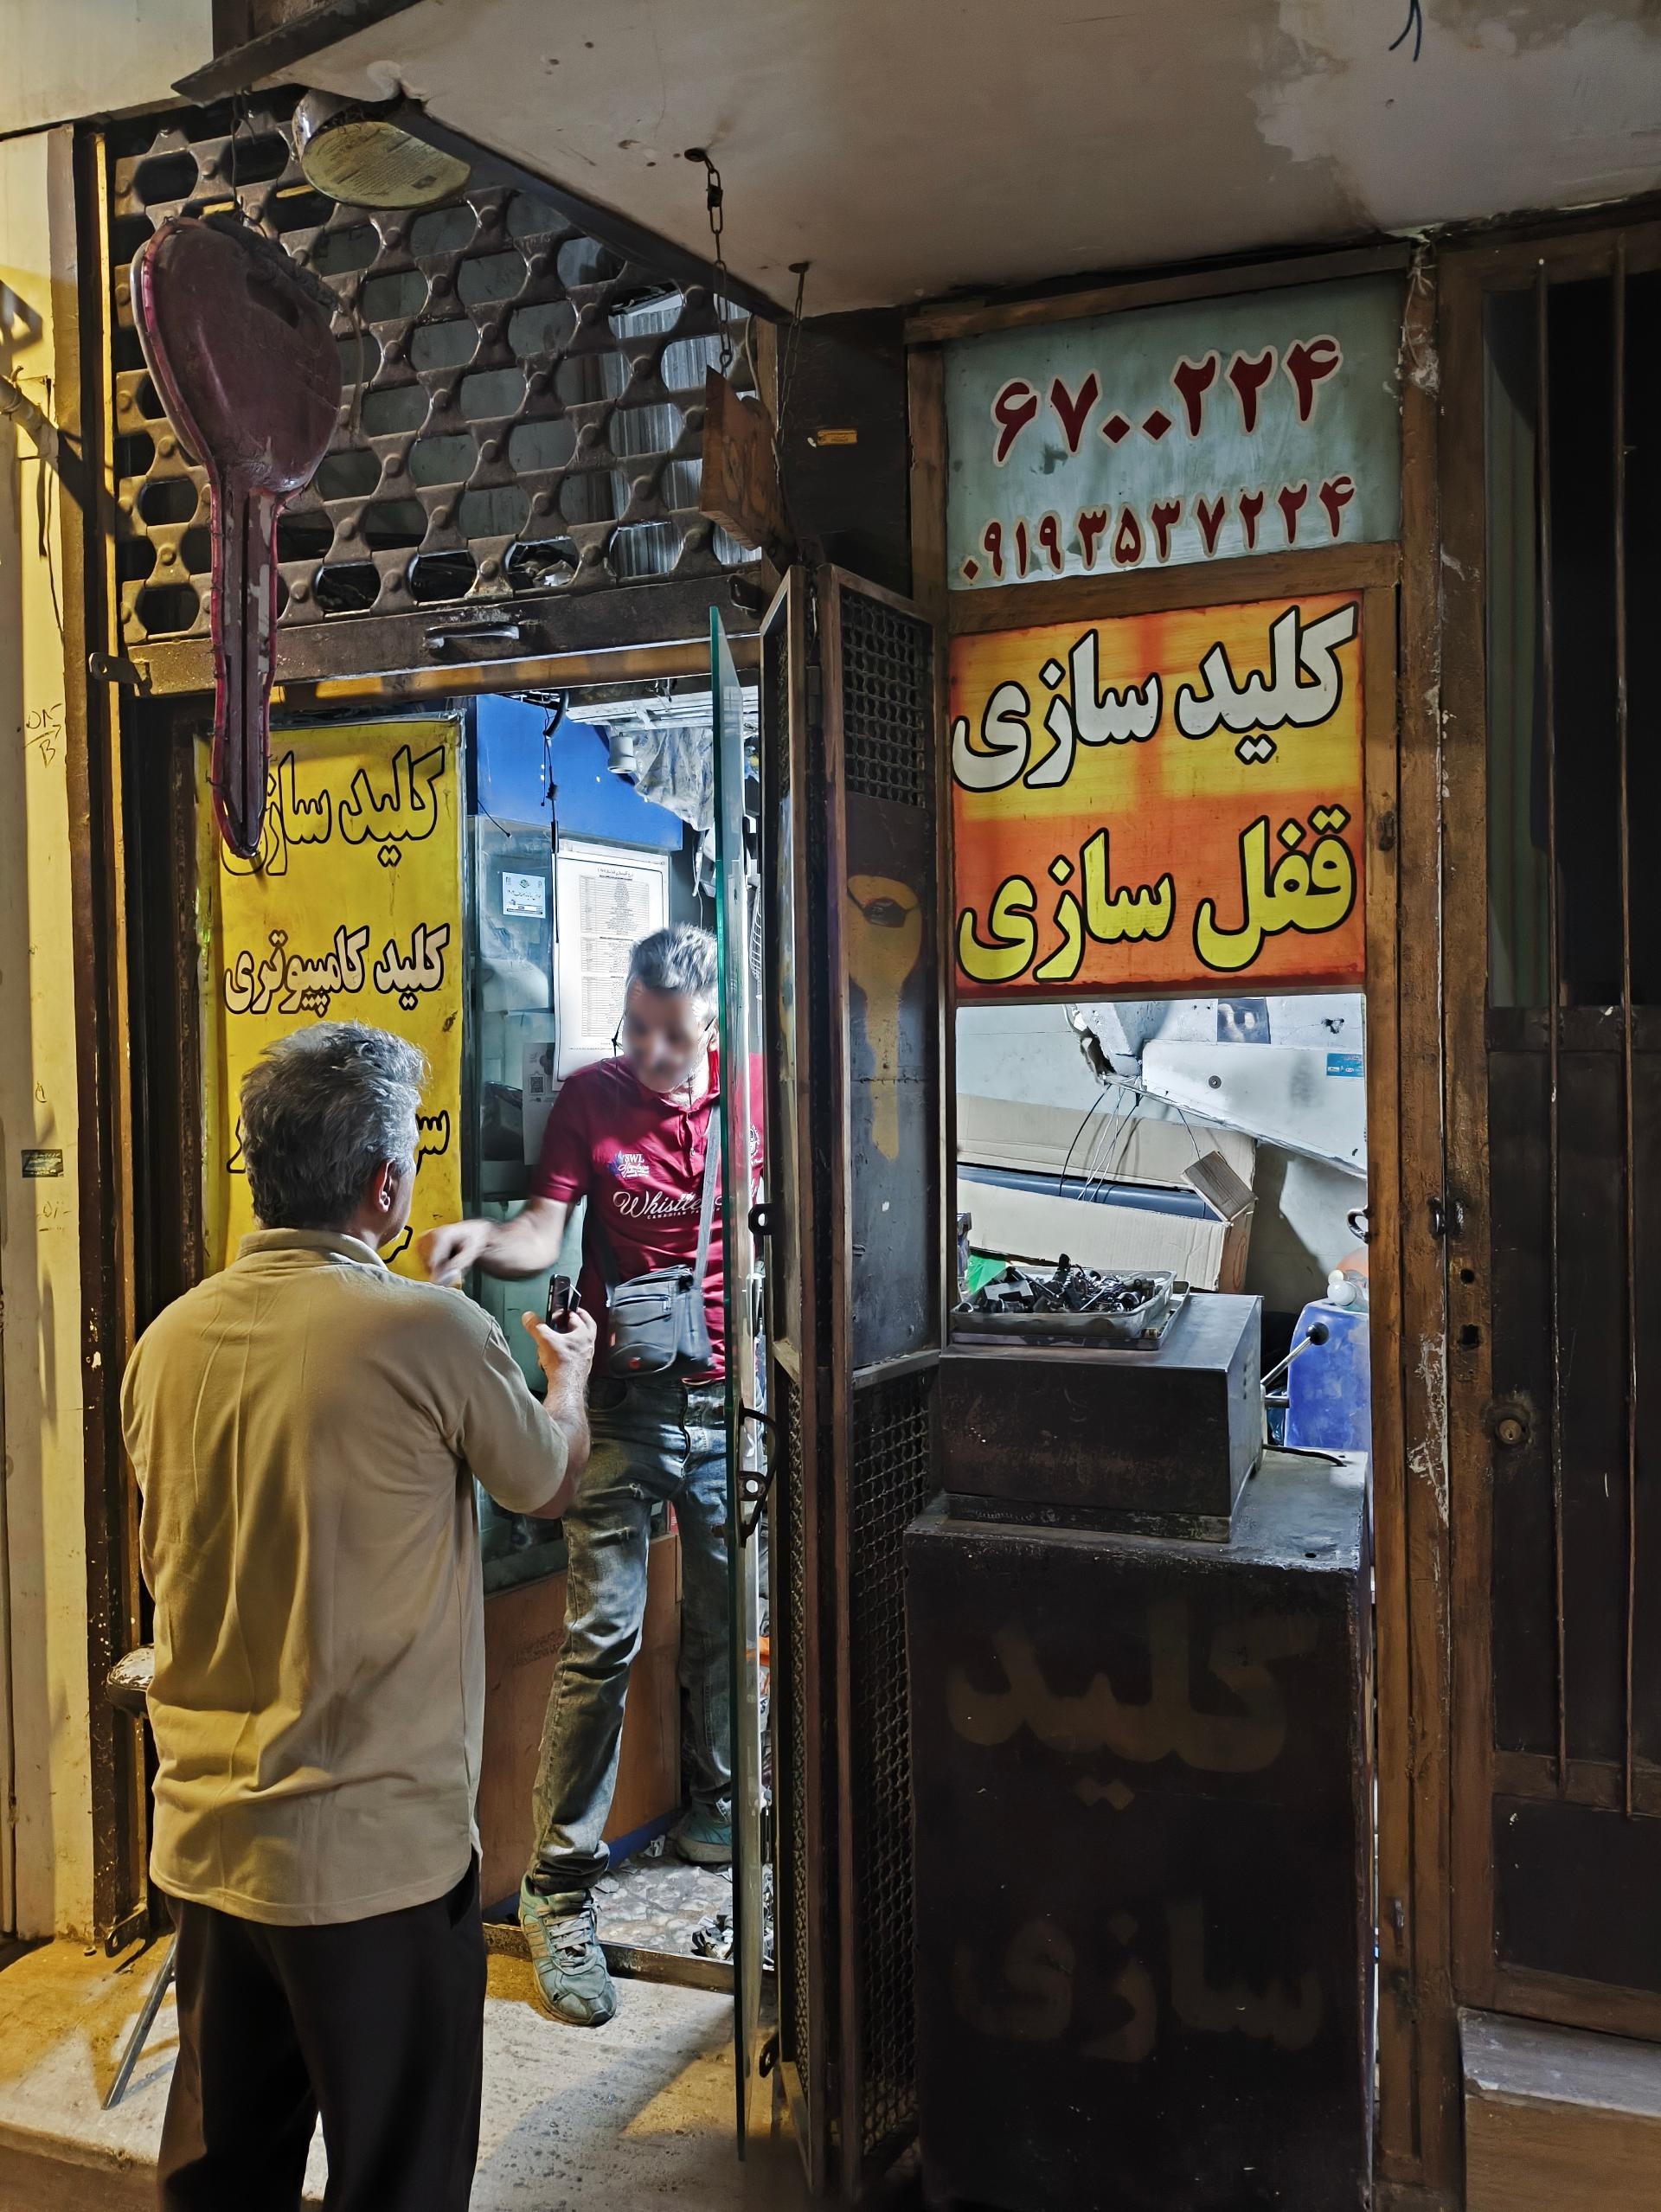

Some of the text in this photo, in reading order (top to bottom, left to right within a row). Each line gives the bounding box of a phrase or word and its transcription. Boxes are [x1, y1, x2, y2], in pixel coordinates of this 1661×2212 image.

[991, 334, 1343, 467] ۶۷۰۰۲۲۴
[959, 476, 1356, 585] ۰۹۱۹۳۵۳۷۲۲۴
[951, 600, 1359, 793] کلید سازی
[338, 745, 446, 867] کلید
[957, 804, 1357, 982] قفل سازی
[222, 922, 451, 1018] کلید کامپیوتری
[612, 1190, 702, 1218] Whistle
[947, 1597, 1319, 1811] کلید
